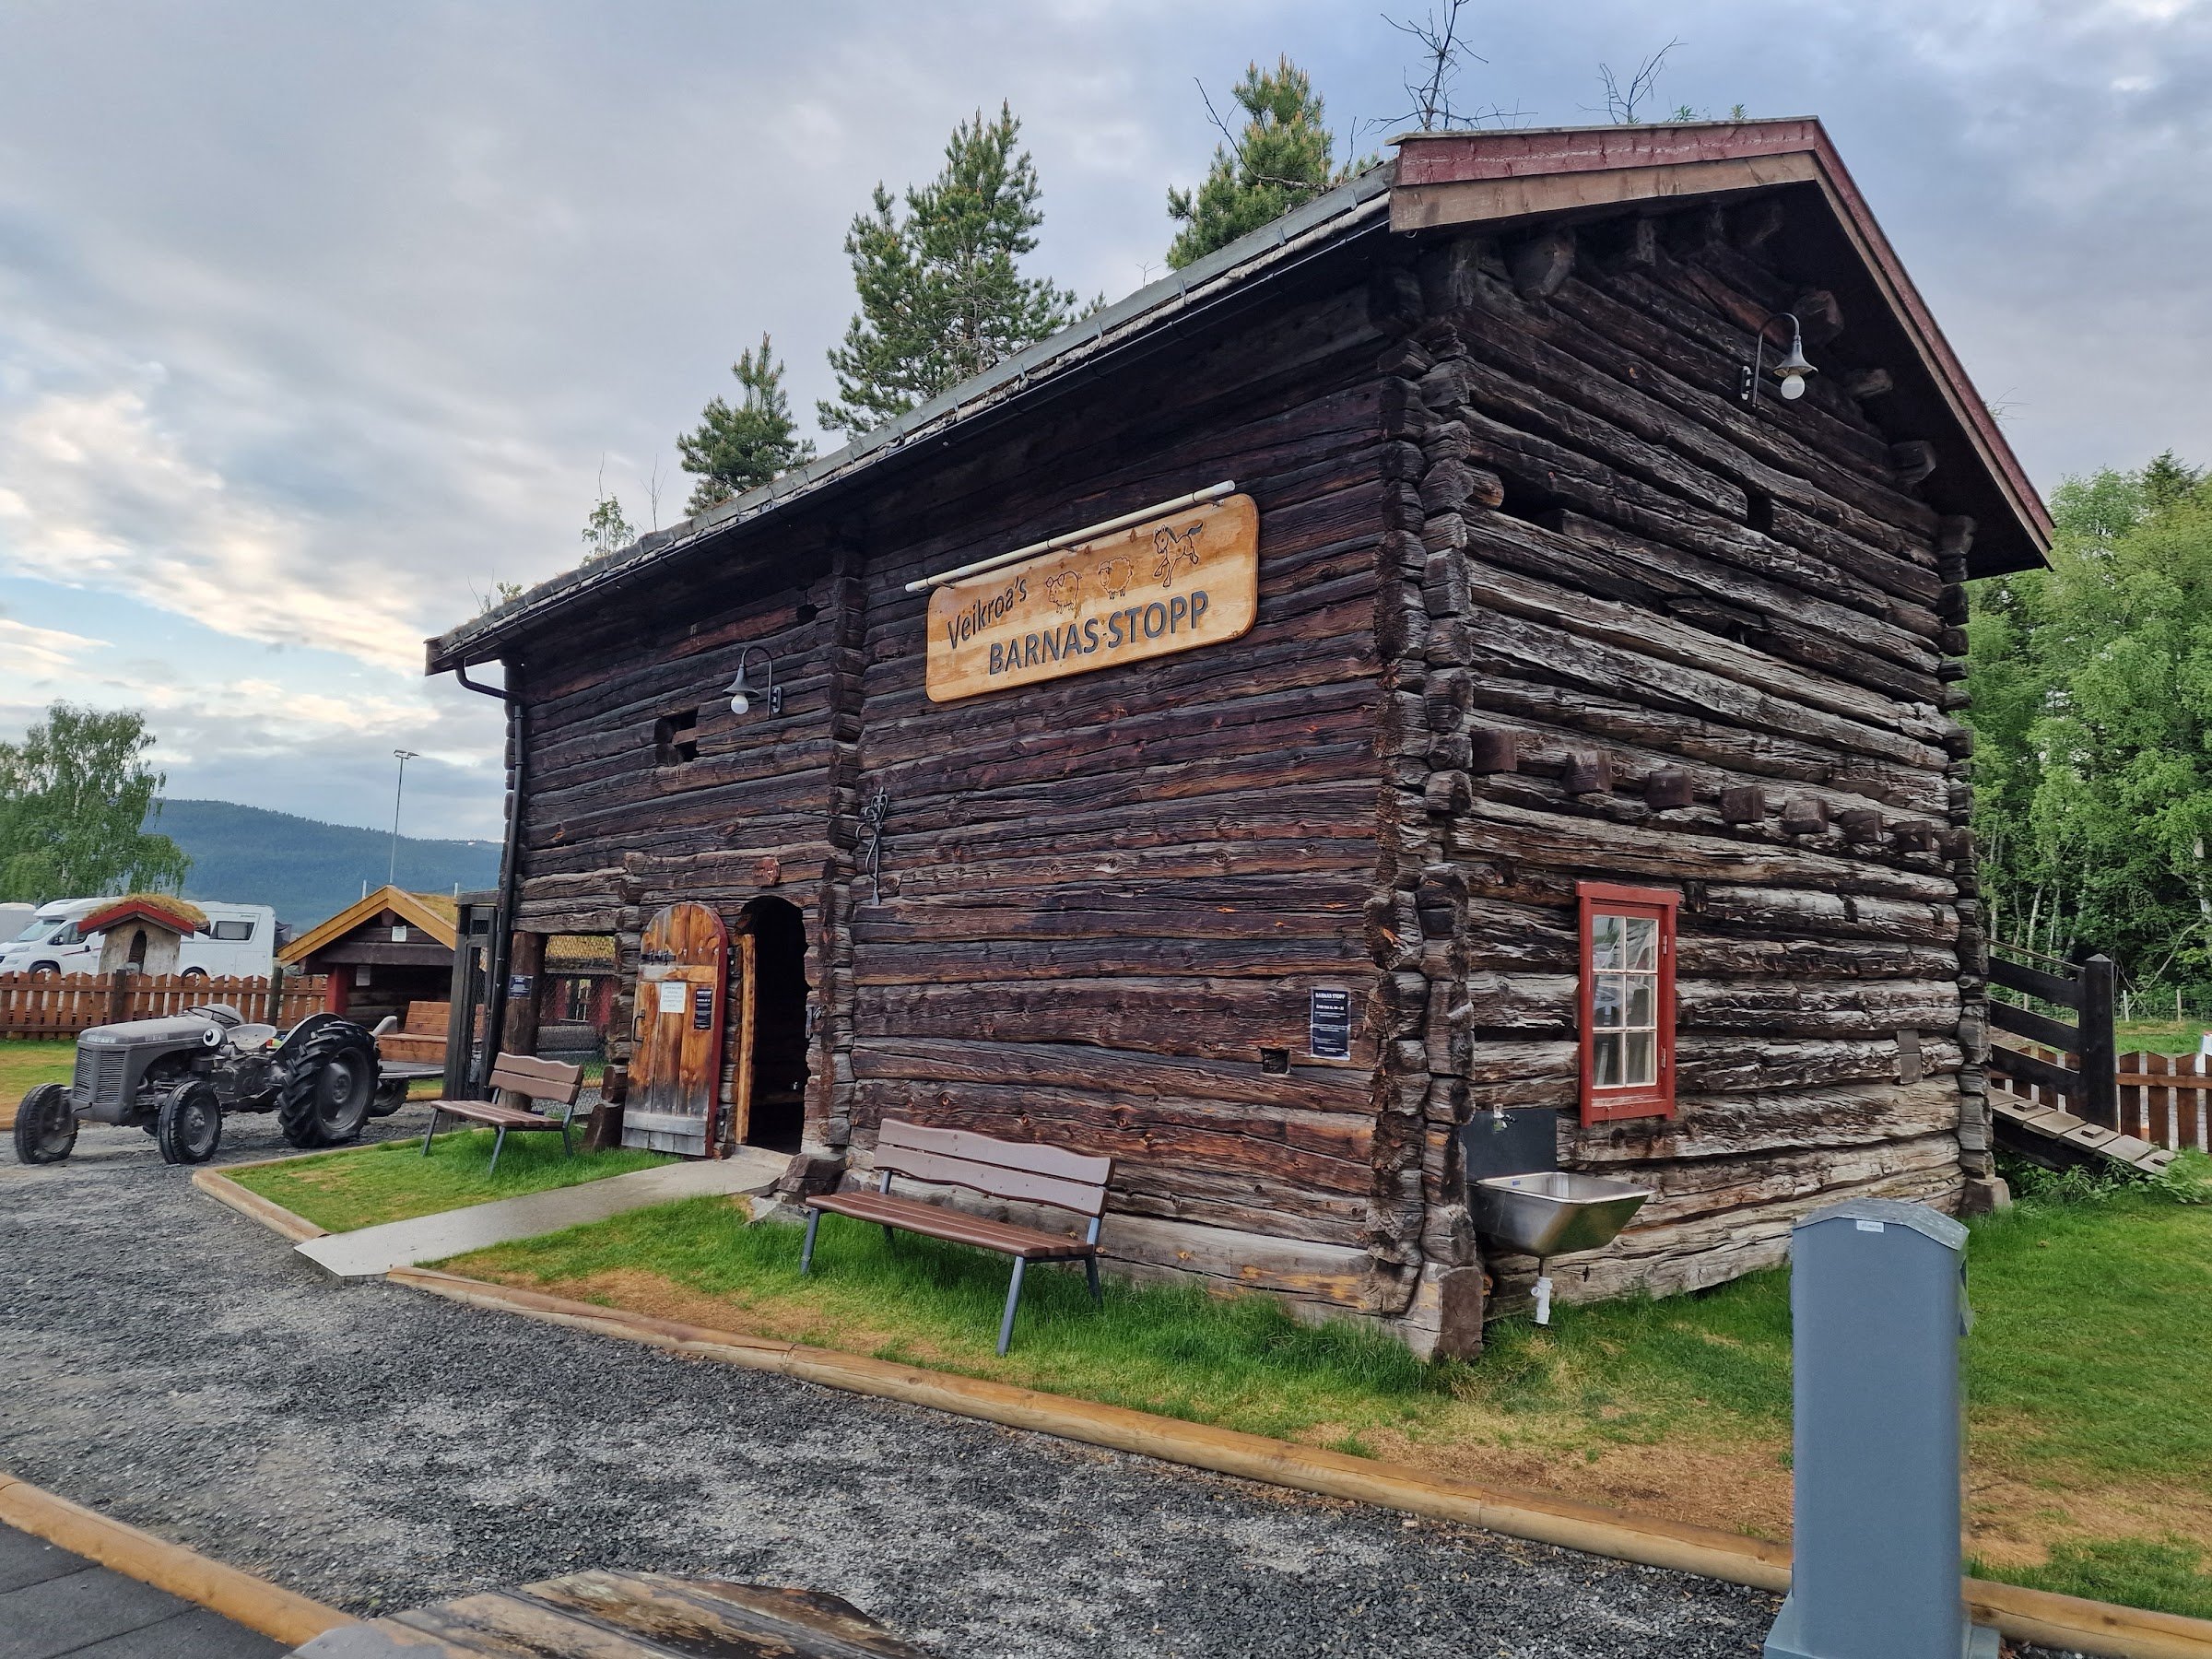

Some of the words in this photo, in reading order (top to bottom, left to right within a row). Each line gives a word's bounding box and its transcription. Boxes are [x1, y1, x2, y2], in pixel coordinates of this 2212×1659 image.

[947, 575, 1028, 650] Veikroa's
[989, 618, 1100, 676] BARNAS
[1108, 590, 1209, 649] STOPP
